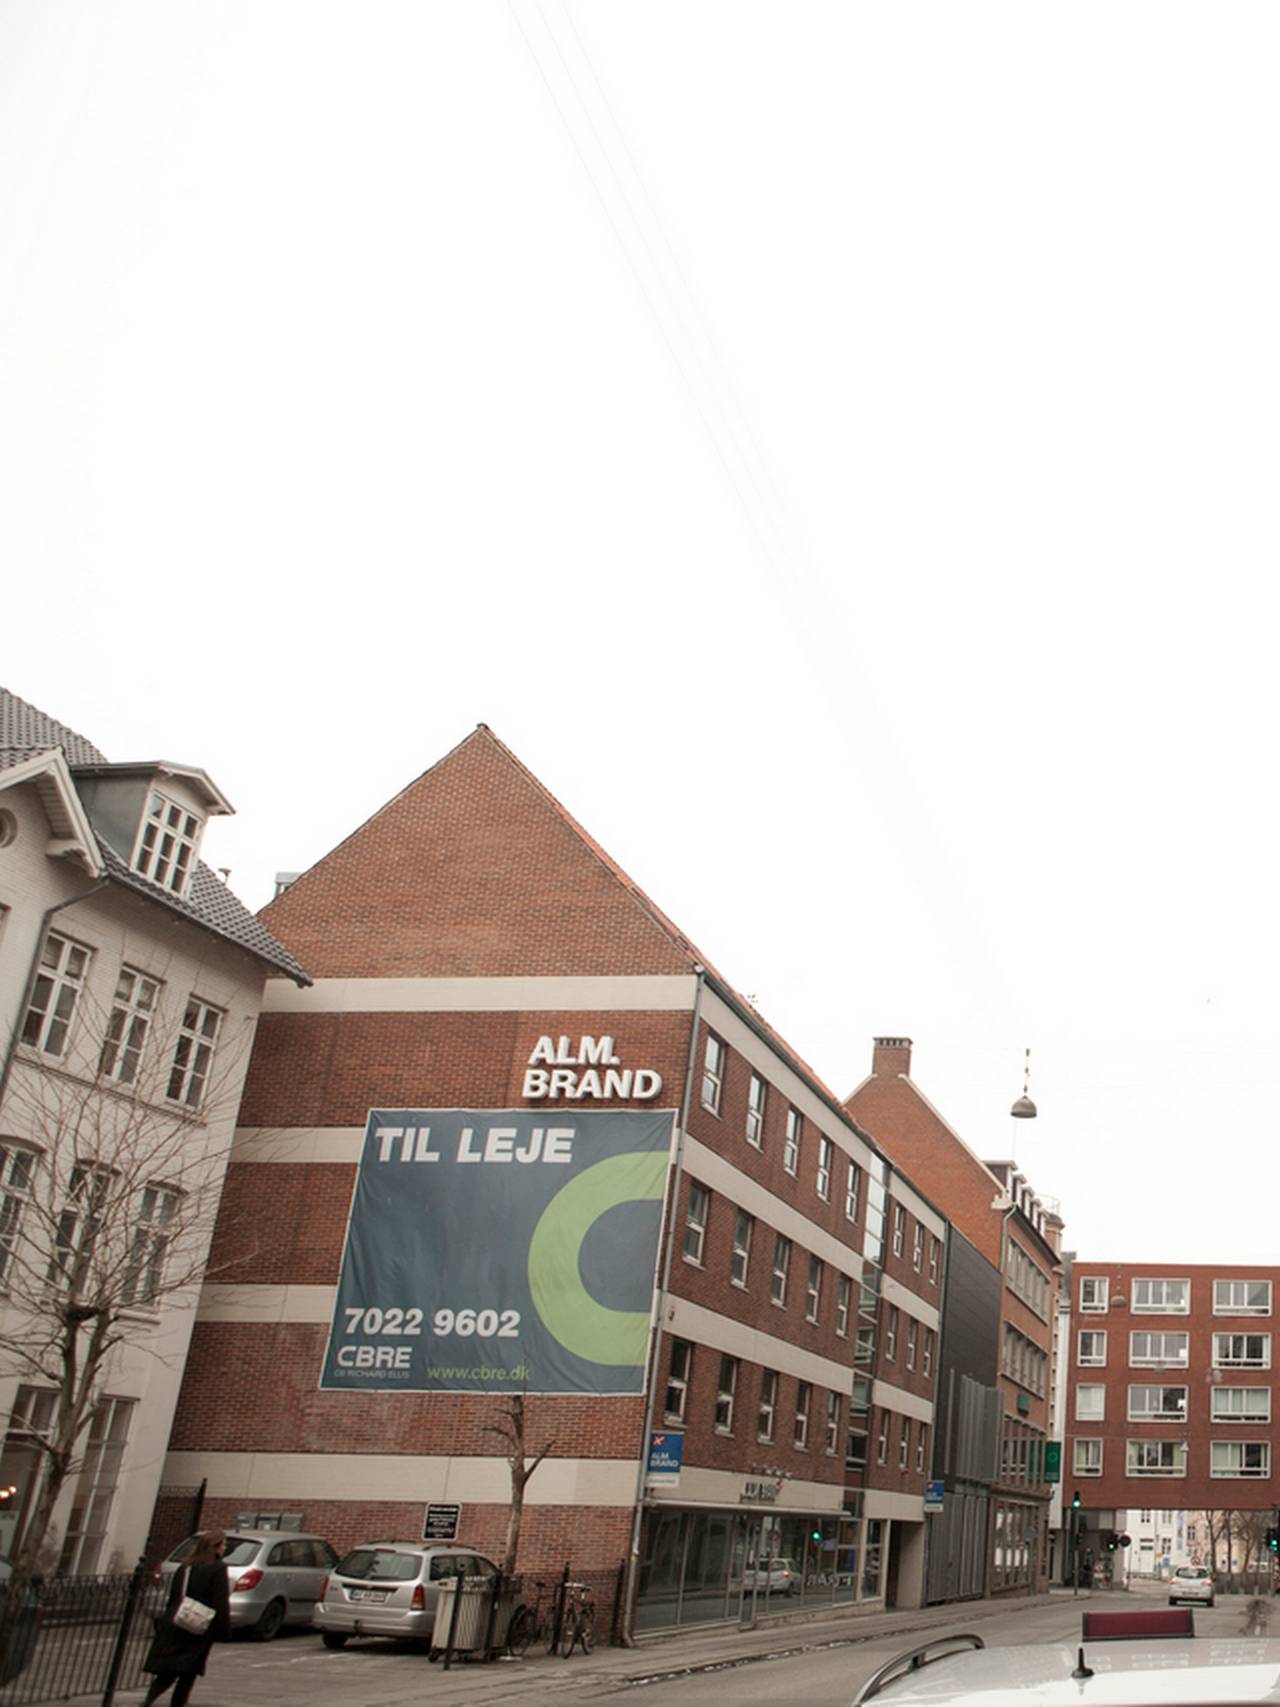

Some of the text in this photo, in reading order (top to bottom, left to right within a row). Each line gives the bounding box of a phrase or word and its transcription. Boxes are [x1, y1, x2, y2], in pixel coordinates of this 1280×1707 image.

[528, 1035, 621, 1066] ALM.
[522, 1069, 662, 1099] BRAND
[375, 1127, 575, 1163] TIL LEJE
[345, 1308, 521, 1337] 7022 9602
[337, 1346, 413, 1369] CBRE
[347, 1370, 387, 1379] RICHARD
[388, 1371, 410, 1379] ELLIS
[427, 1365, 529, 1381] www.cbre.dk
